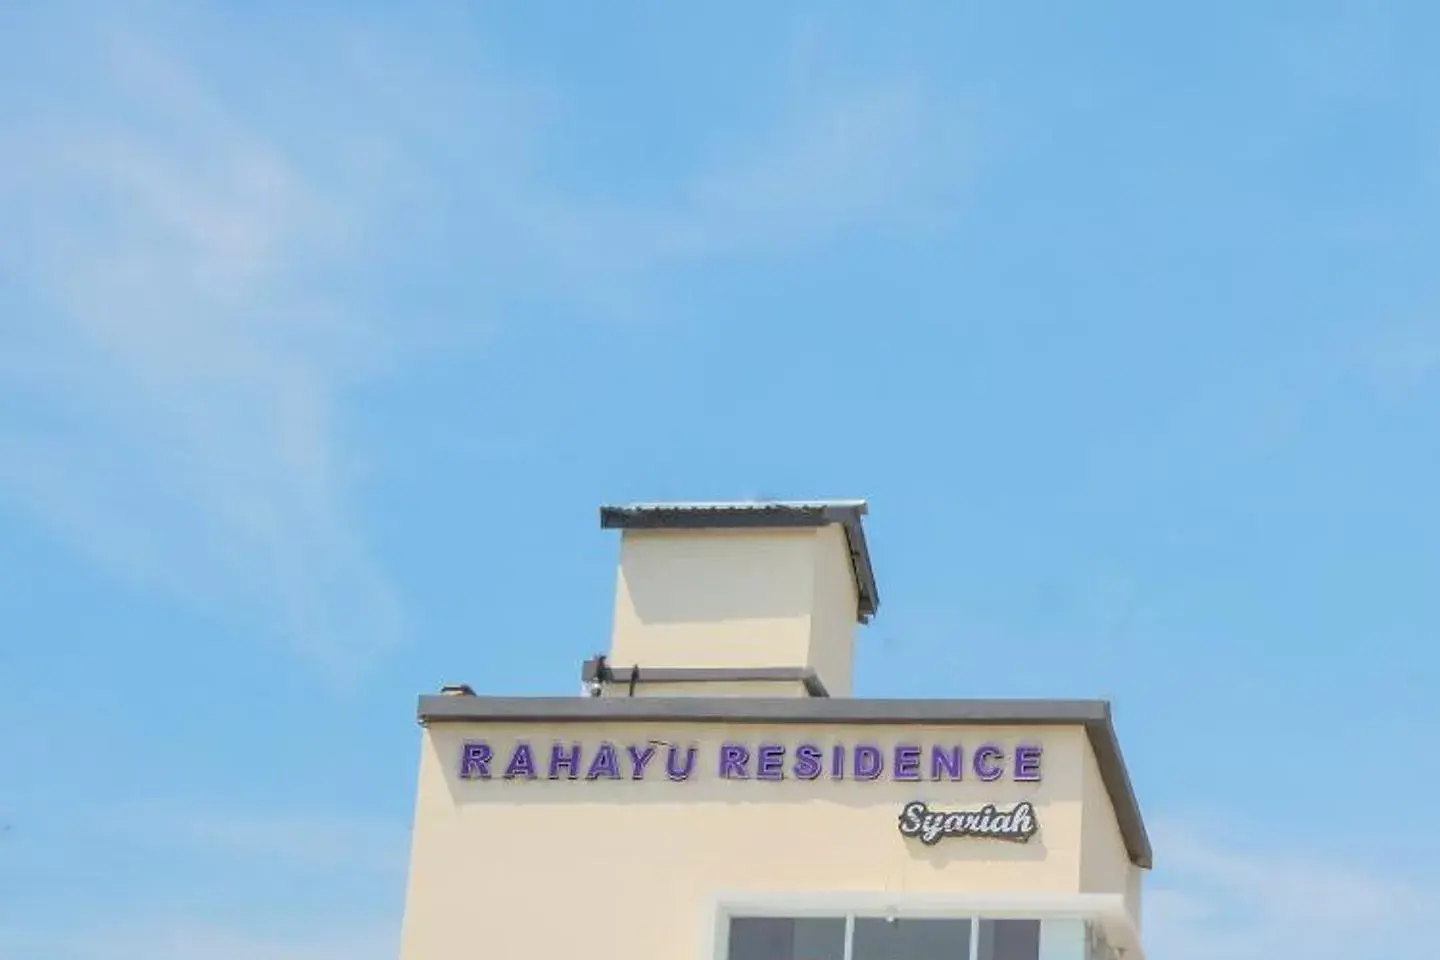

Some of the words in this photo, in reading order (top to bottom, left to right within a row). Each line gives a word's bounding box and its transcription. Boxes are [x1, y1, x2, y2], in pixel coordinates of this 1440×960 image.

[459, 741, 698, 782] RAHAYU
[718, 743, 1043, 782] RESIDENCE
[900, 802, 1036, 843] Syariah
